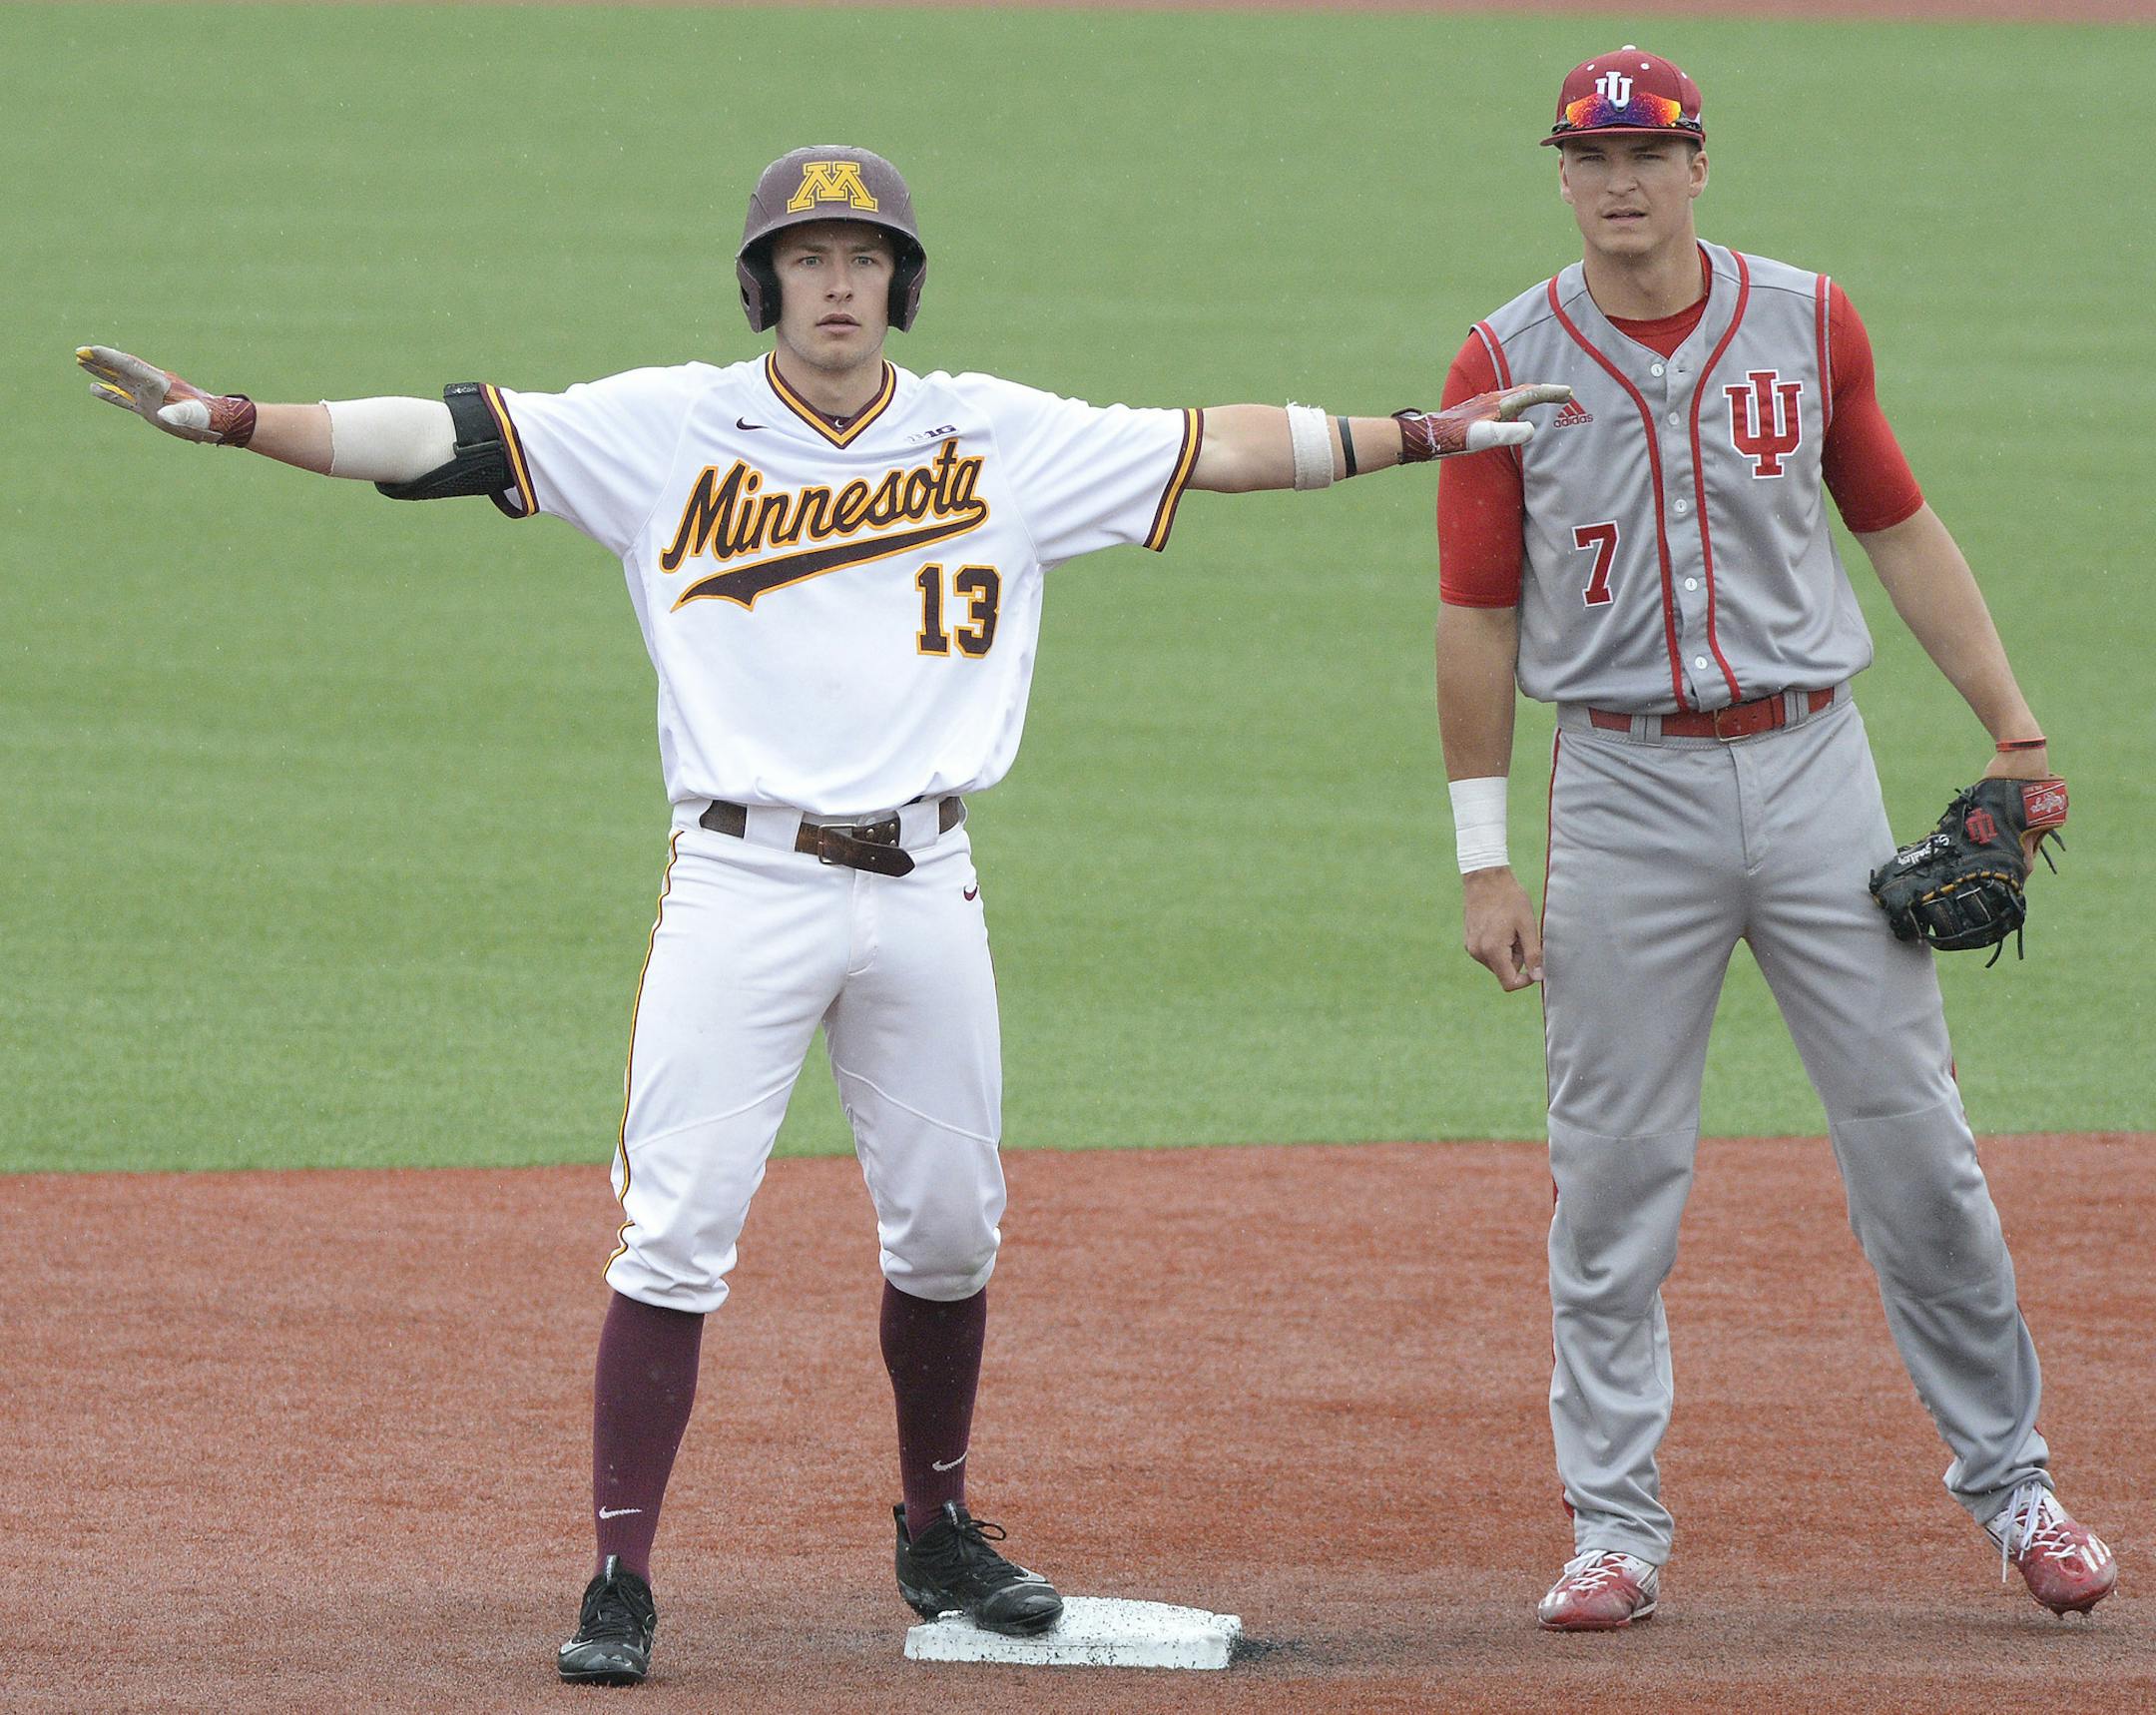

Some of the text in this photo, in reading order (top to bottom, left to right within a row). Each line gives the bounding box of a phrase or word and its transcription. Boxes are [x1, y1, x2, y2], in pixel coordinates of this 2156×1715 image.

[787, 161, 879, 215] M
[1553, 412, 1594, 428] adidas
[1723, 369, 1803, 479] IU
[660, 438, 990, 574] Minnesota
[1571, 520, 1620, 607] 7
[913, 562, 1002, 660] 13
